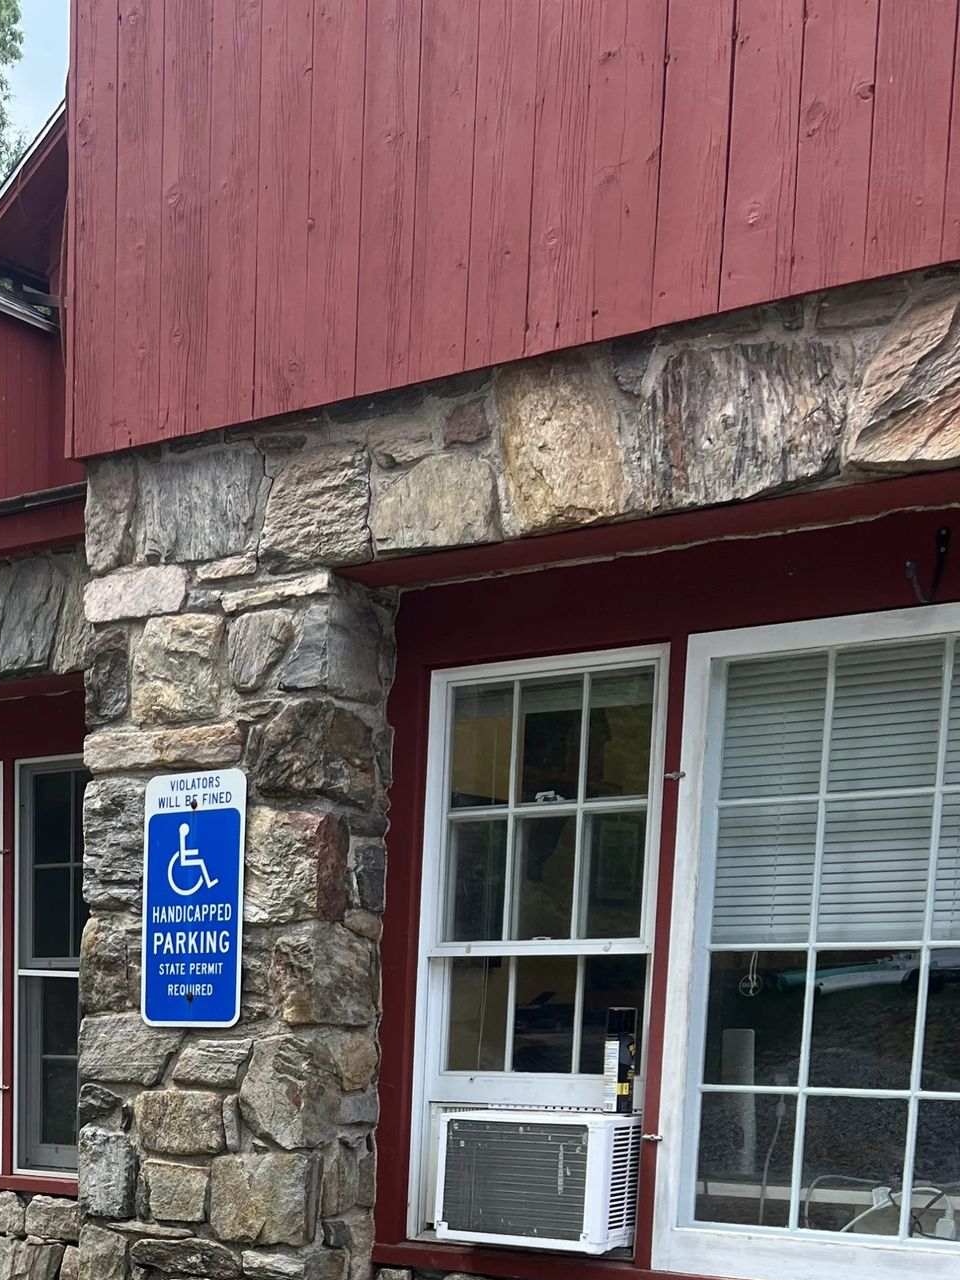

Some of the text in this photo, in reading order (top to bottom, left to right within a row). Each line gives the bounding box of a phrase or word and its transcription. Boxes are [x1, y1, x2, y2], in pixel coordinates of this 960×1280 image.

[170, 776, 220, 791] VIOLATORS
[158, 796, 180, 808] WILL
[202, 791, 232, 805] FINED
[152, 903, 232, 923] HANDICAPPED
[153, 930, 230, 954] PARKING
[158, 962, 223, 975] STATE PERMIT
[167, 983, 213, 996] REQUIRED
